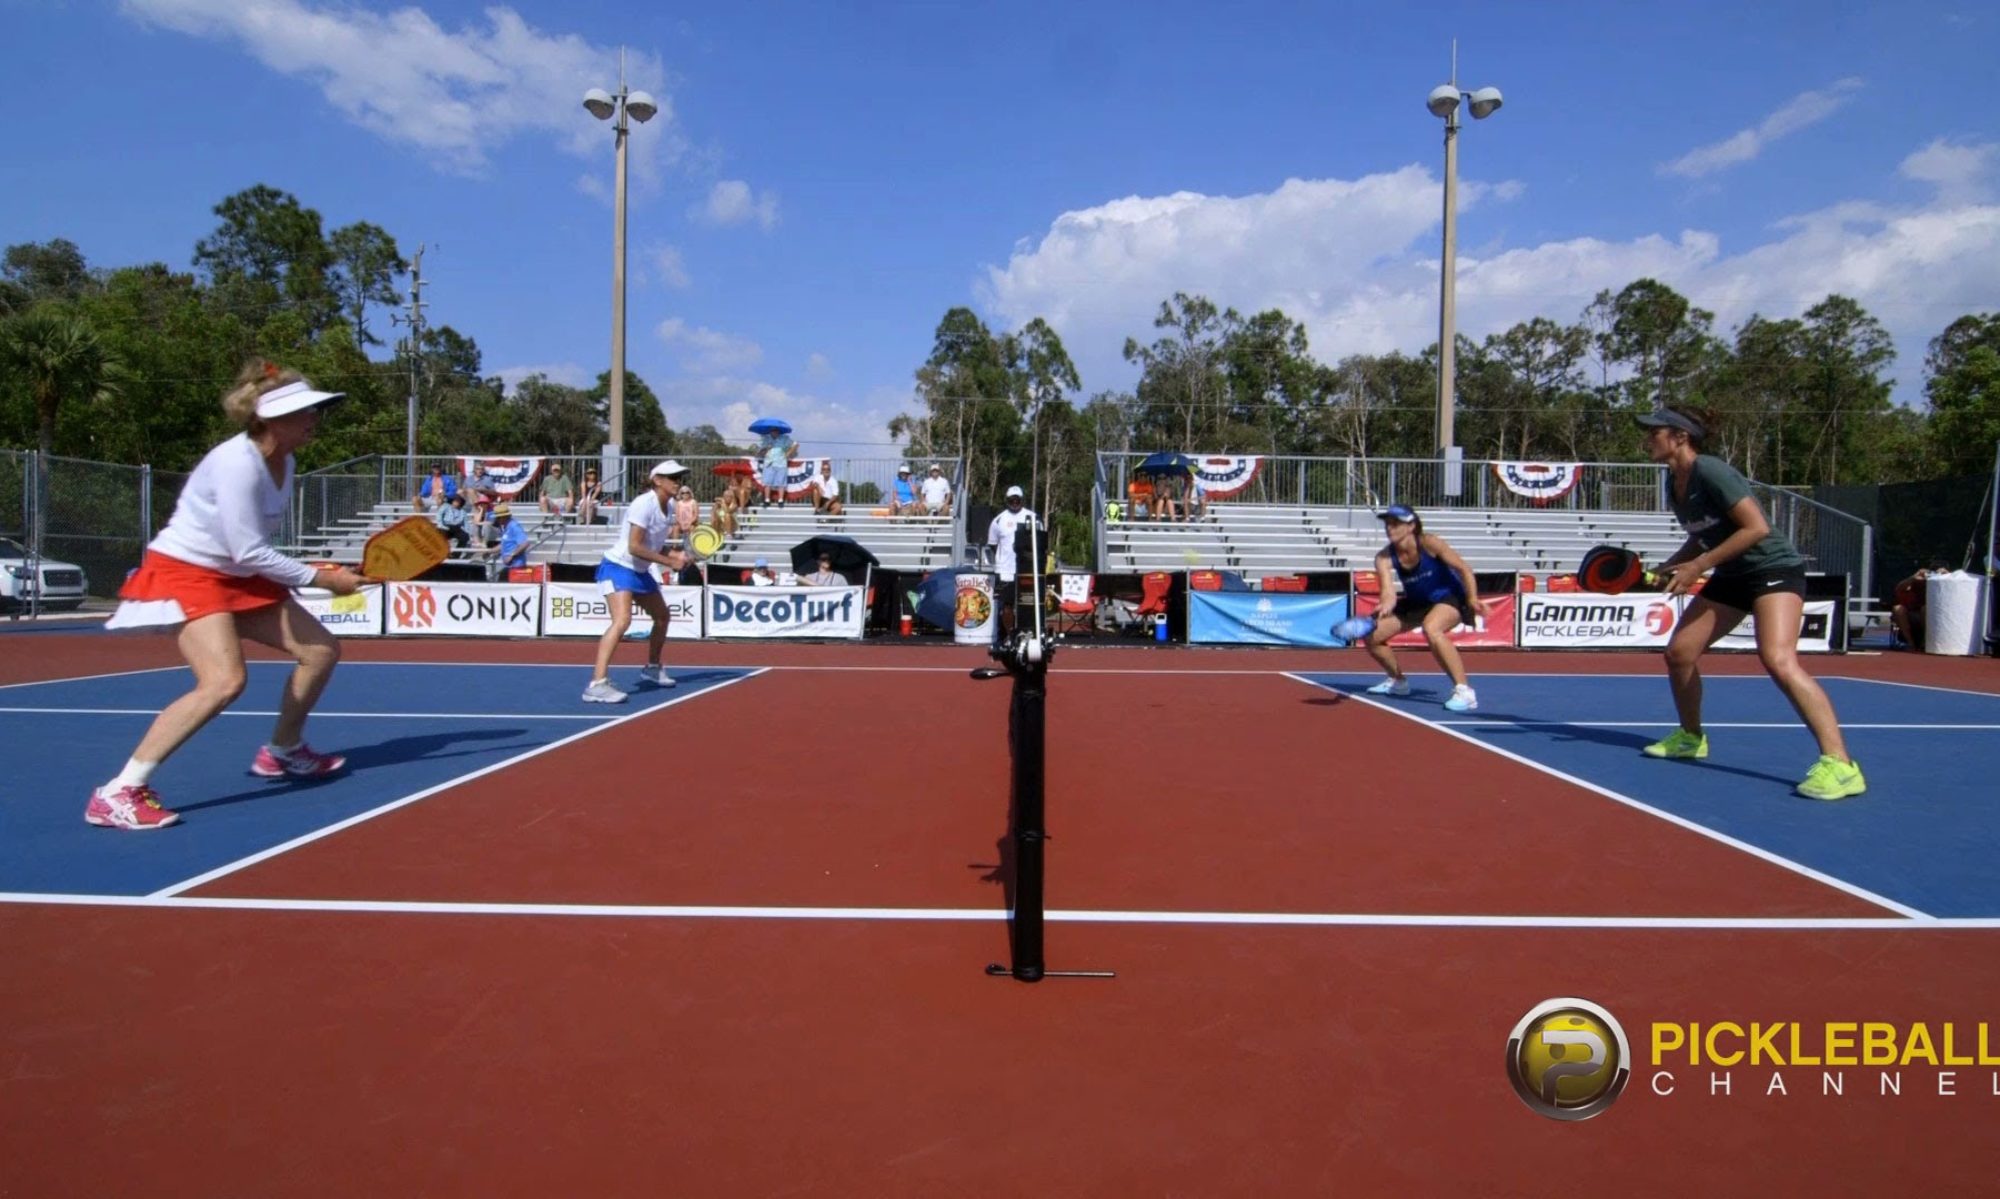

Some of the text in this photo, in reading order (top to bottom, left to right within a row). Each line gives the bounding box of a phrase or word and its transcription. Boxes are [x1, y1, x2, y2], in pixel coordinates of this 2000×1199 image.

[447, 594, 531, 622] ONIX
[712, 592, 853, 623] DecoTurf
[1525, 602, 1635, 622] GAMMA
[320, 614, 371, 624] EBALL
[1525, 625, 1637, 637] PICKLEBALL
